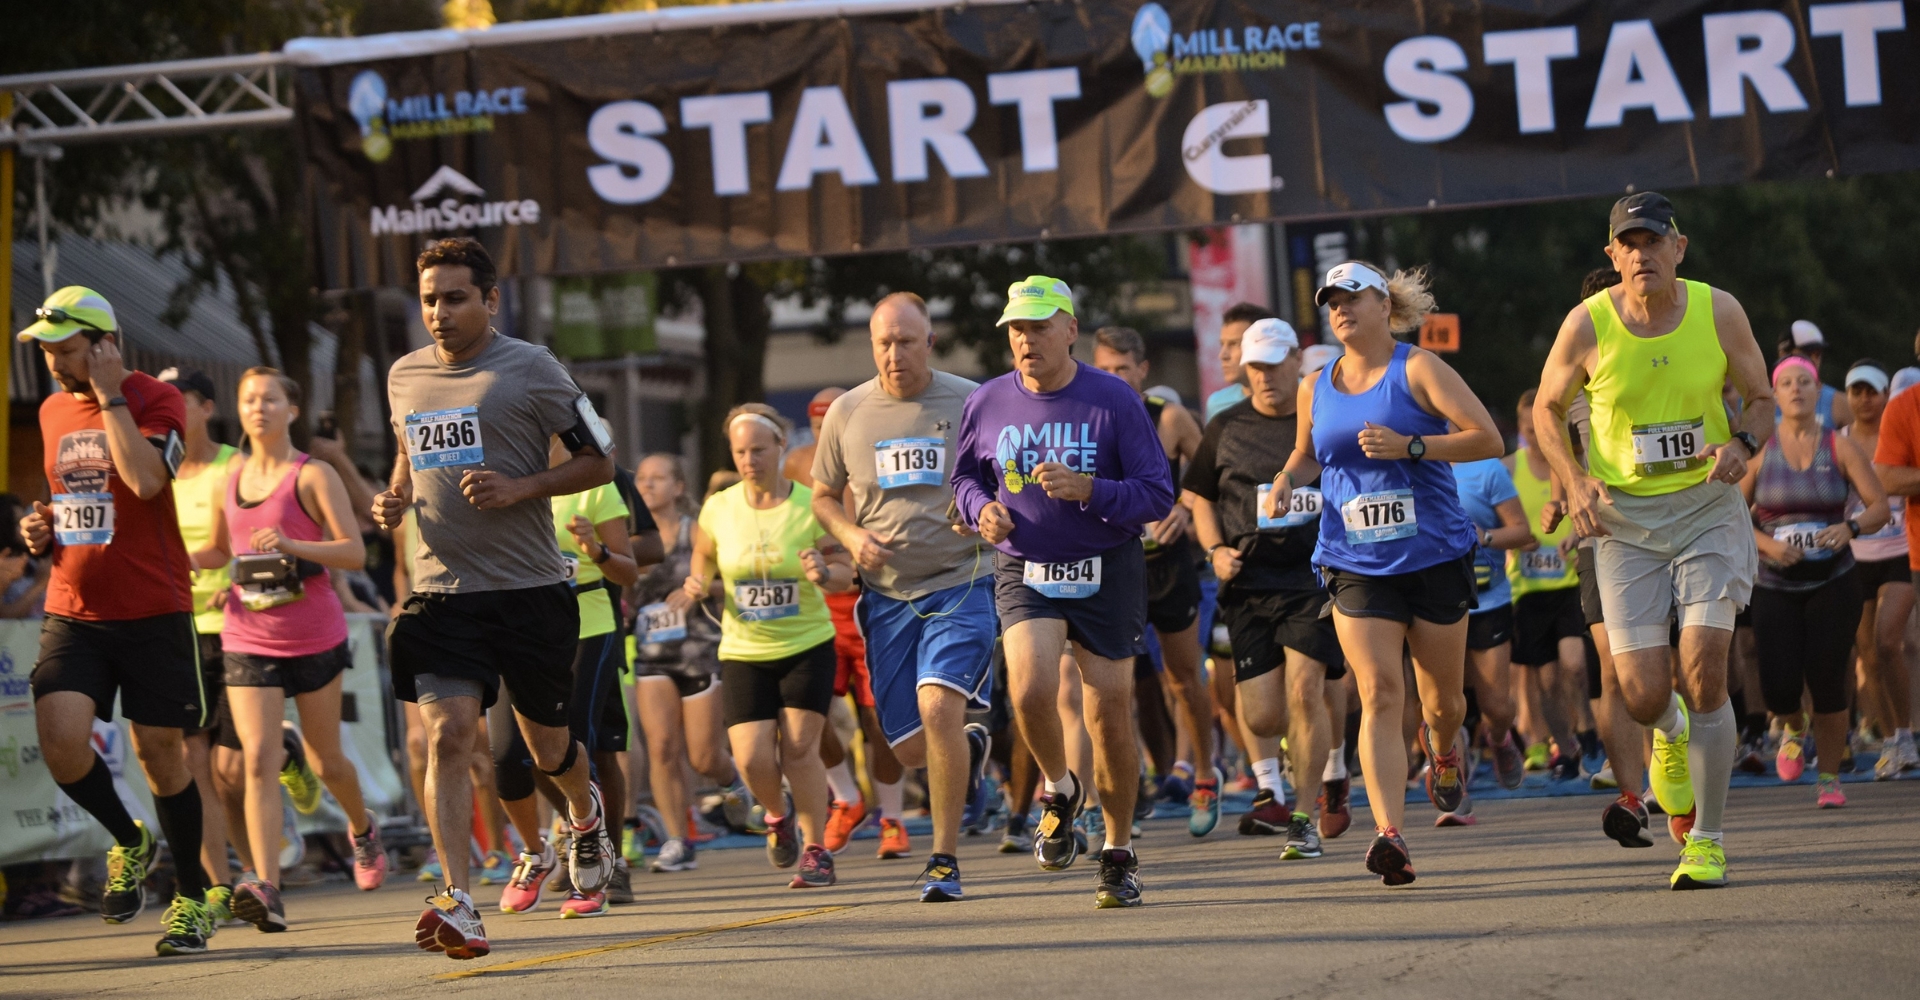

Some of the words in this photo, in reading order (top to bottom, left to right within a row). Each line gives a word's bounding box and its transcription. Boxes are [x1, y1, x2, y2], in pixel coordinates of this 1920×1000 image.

[1171, 27, 1240, 58] MILL
[1244, 22, 1321, 51] RACE
[1174, 51, 1286, 73] MARATHON
[1383, 1, 1906, 143] START
[386, 92, 453, 124] MILL
[455, 86, 528, 115] RACE
[586, 67, 1082, 204] START
[1184, 100, 1258, 161] Cummins
[370, 198, 541, 236] MainSource
[435, 413, 462, 421] MARATHON
[1662, 424, 1692, 432] MARATHON
[418, 420, 475, 451] 2436
[1022, 422, 1097, 448] MILL
[1656, 431, 1695, 458] 119
[891, 448, 938, 471] 1139
[1673, 460, 1687, 469] TOM
[1292, 493, 1317, 513] 36
[1359, 501, 1406, 527] 1776
[64, 505, 106, 529] 2197
[1041, 560, 1095, 582] 1654
[747, 585, 794, 607] 2587
[1060, 585, 1077, 594] CRAIG
